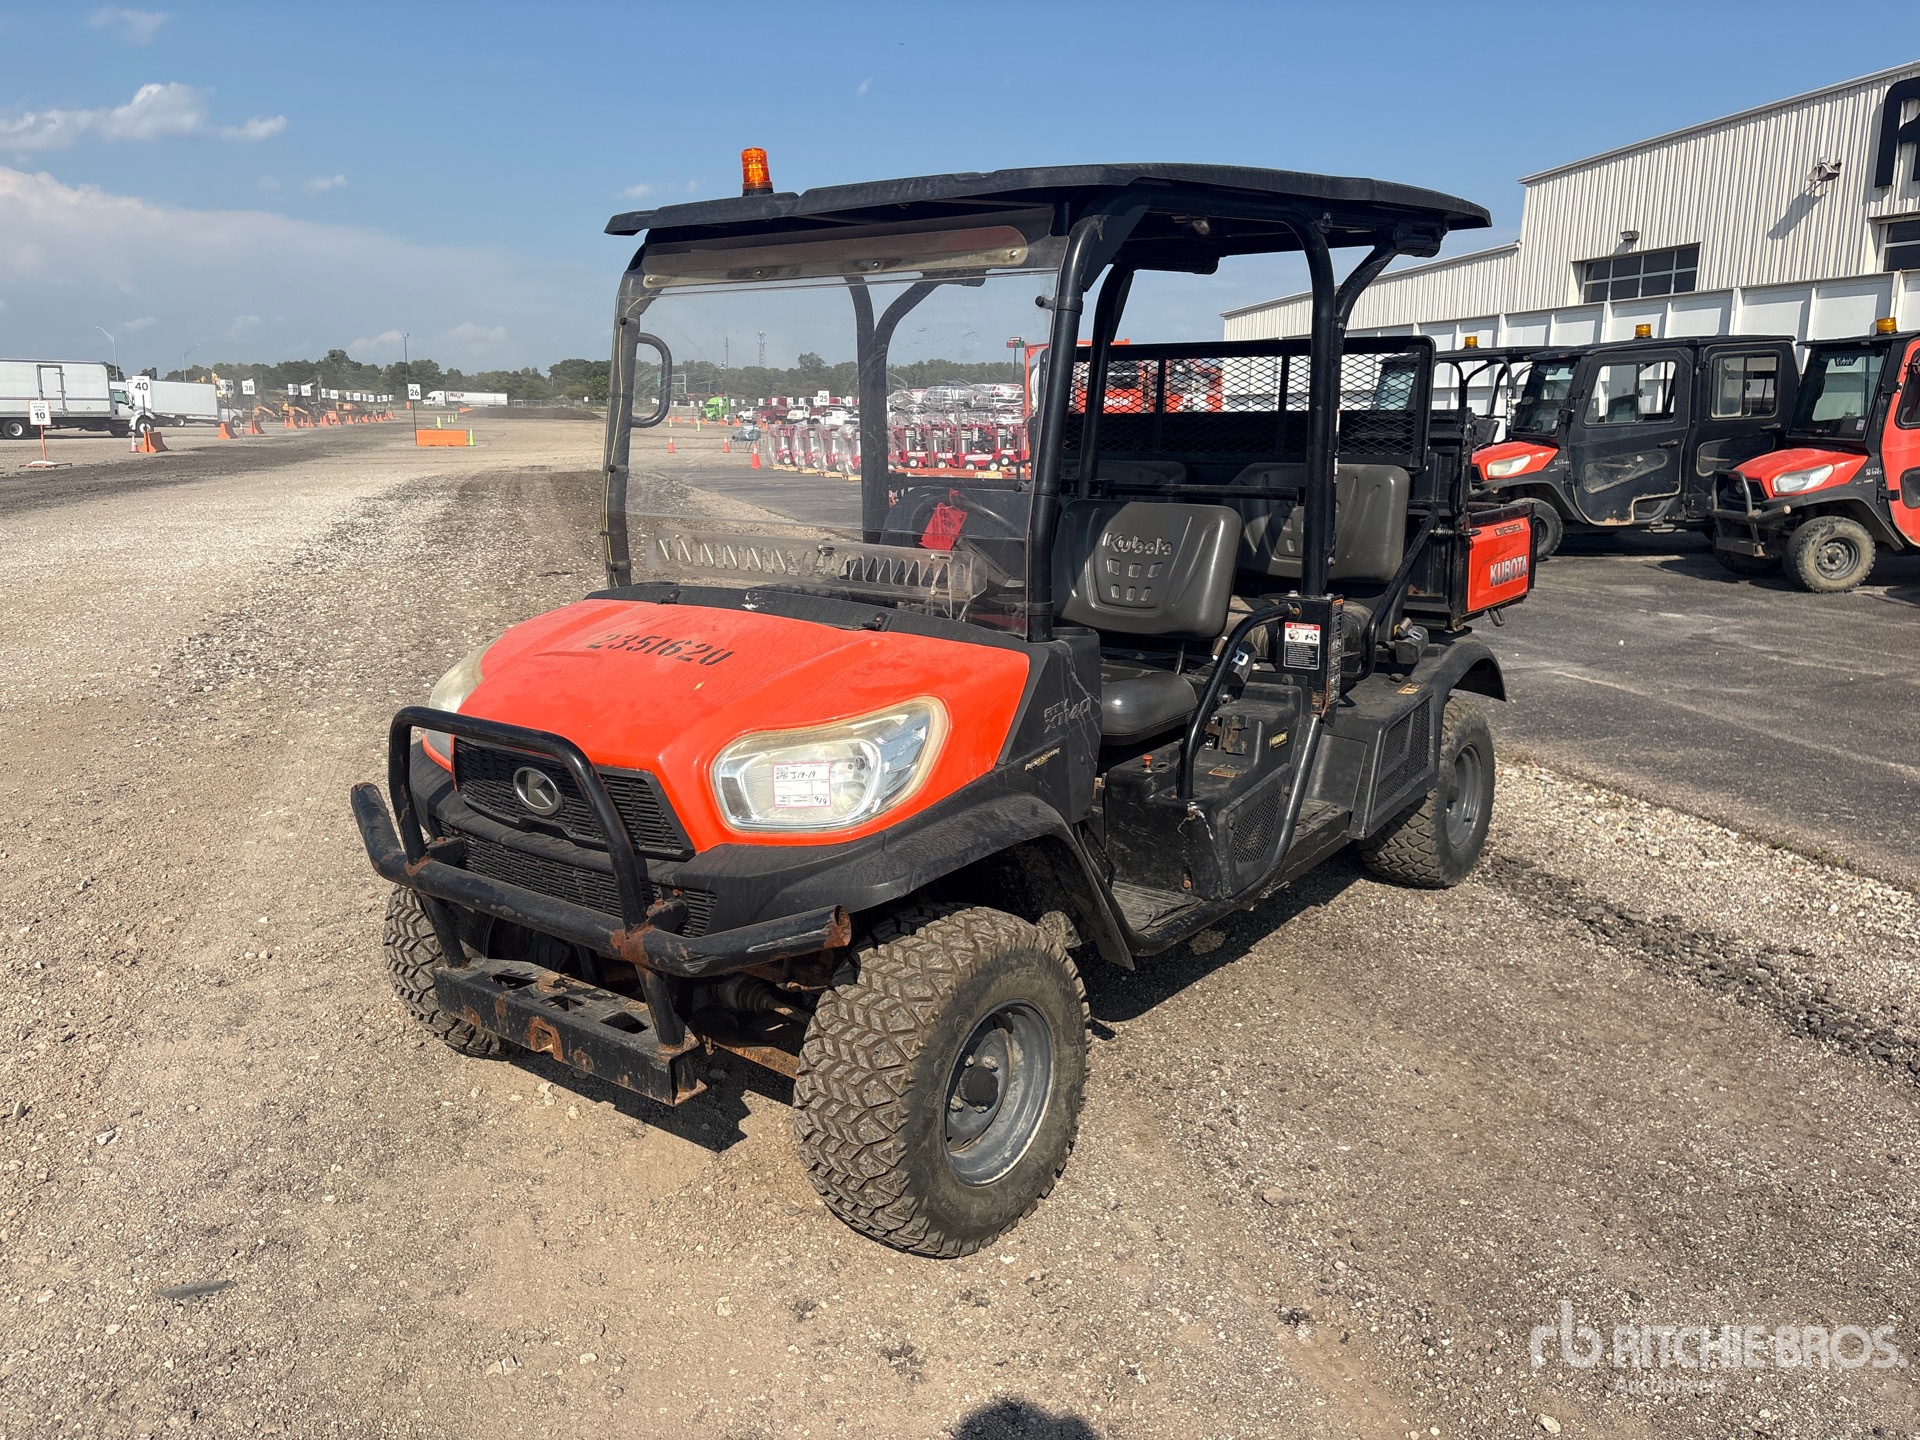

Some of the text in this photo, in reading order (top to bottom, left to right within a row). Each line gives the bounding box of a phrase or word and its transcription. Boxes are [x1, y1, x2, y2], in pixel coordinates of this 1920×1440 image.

[135, 382, 148, 391] 40
[1494, 523, 1525, 536] DIESEL
[1102, 532, 1173, 555] Kubota
[1490, 555, 1527, 586] KUBOTA
[587, 633, 734, 666] 2351620
